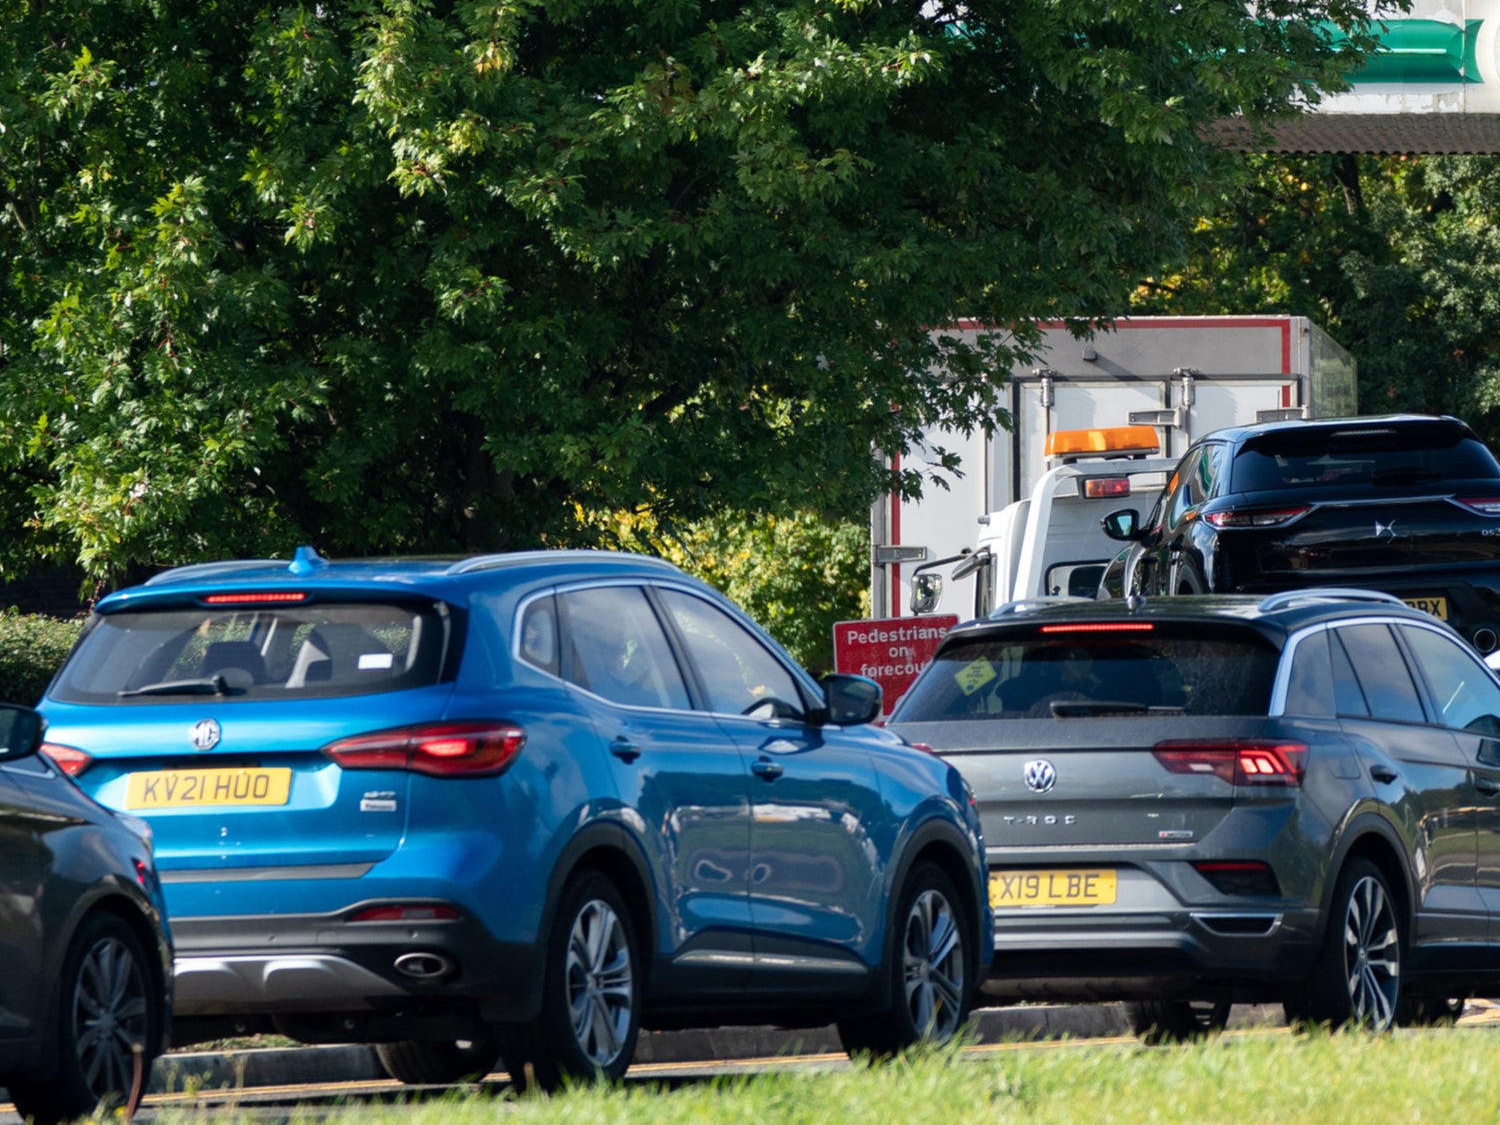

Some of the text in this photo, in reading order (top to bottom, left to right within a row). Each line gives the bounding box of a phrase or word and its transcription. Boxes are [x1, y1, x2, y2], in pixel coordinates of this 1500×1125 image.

[847, 626, 949, 644] Pedestrians
[888, 647, 910, 658] on
[860, 662, 929, 678] forecou
[189, 718, 221, 750] MG
[143, 774, 270, 803] KV21 HUO
[1048, 874, 1101, 898] LBE
